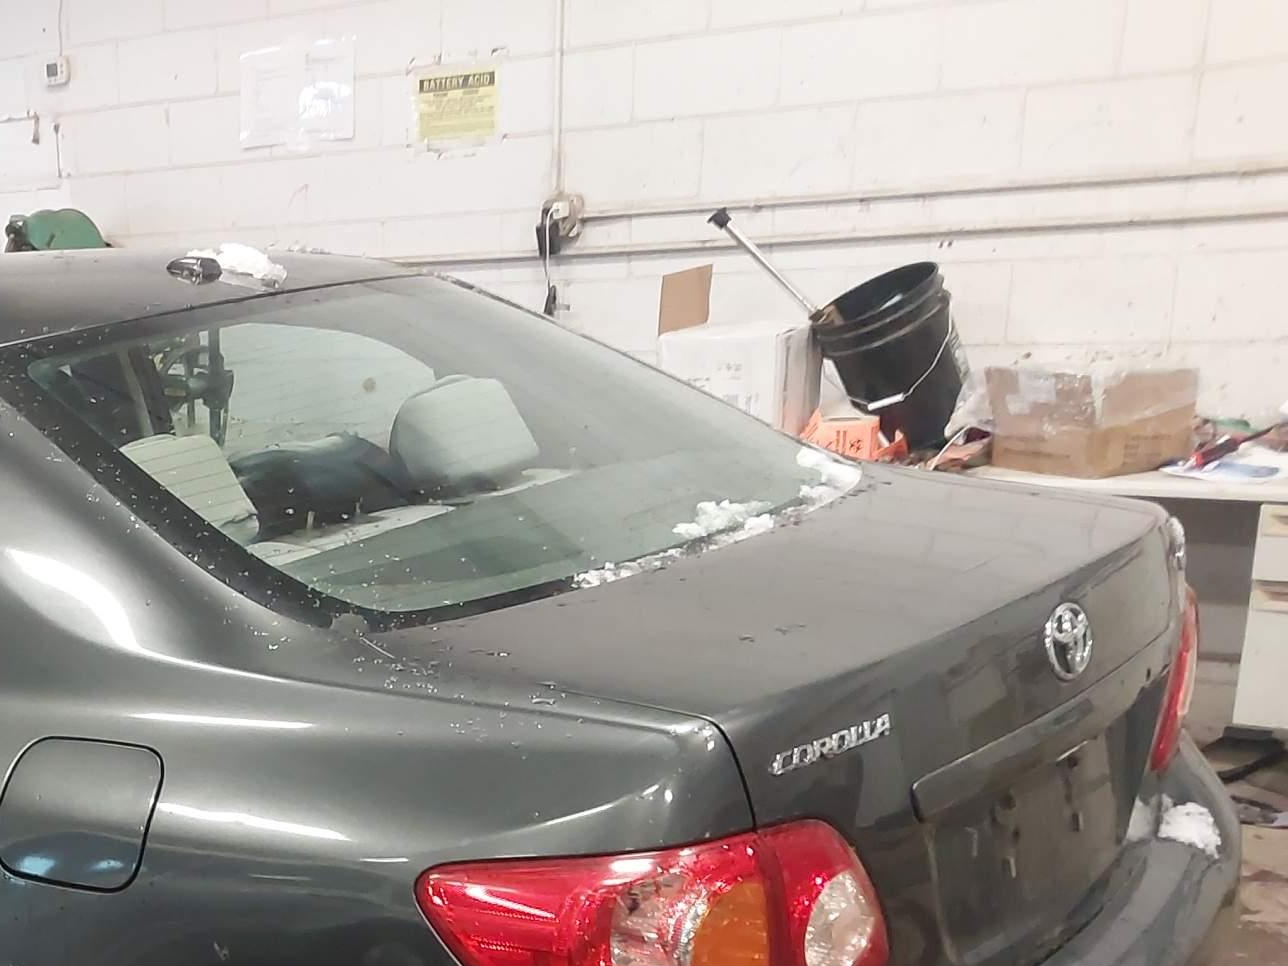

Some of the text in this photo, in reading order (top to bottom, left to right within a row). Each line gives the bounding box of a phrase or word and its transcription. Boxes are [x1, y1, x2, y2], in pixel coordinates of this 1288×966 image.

[423, 74, 491, 91] BATTERY ACID
[768, 713, 891, 776] COROLLA
